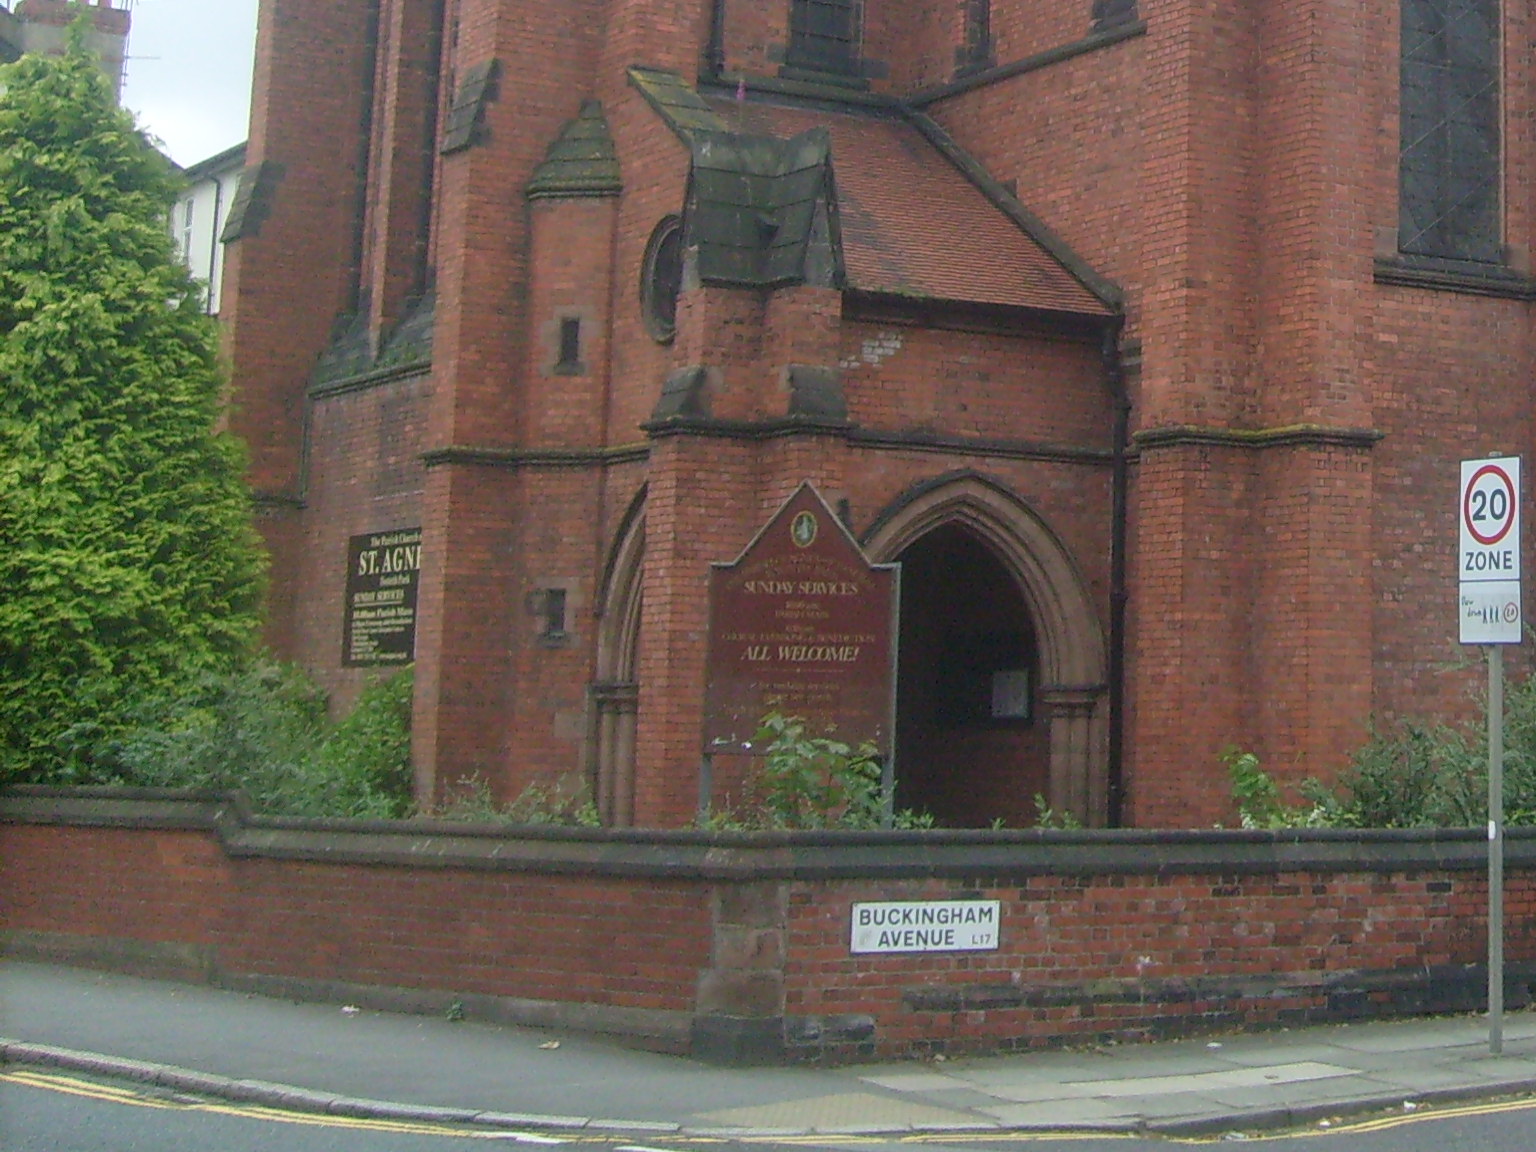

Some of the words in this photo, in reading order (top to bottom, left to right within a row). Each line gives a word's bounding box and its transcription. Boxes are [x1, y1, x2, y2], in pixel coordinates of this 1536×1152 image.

[1472, 488, 1507, 521] 20
[358, 550, 380, 576] ST.
[1465, 550, 1513, 571] ZONE
[744, 581, 796, 595] SUNDAY
[798, 581, 859, 595] SERVICES
[740, 646, 771, 661] ALL
[778, 646, 860, 662] WELCOME!
[859, 907, 993, 926] BUCKINGHAM
[878, 929, 955, 947] AVENUE
[972, 934, 991, 945] L17
